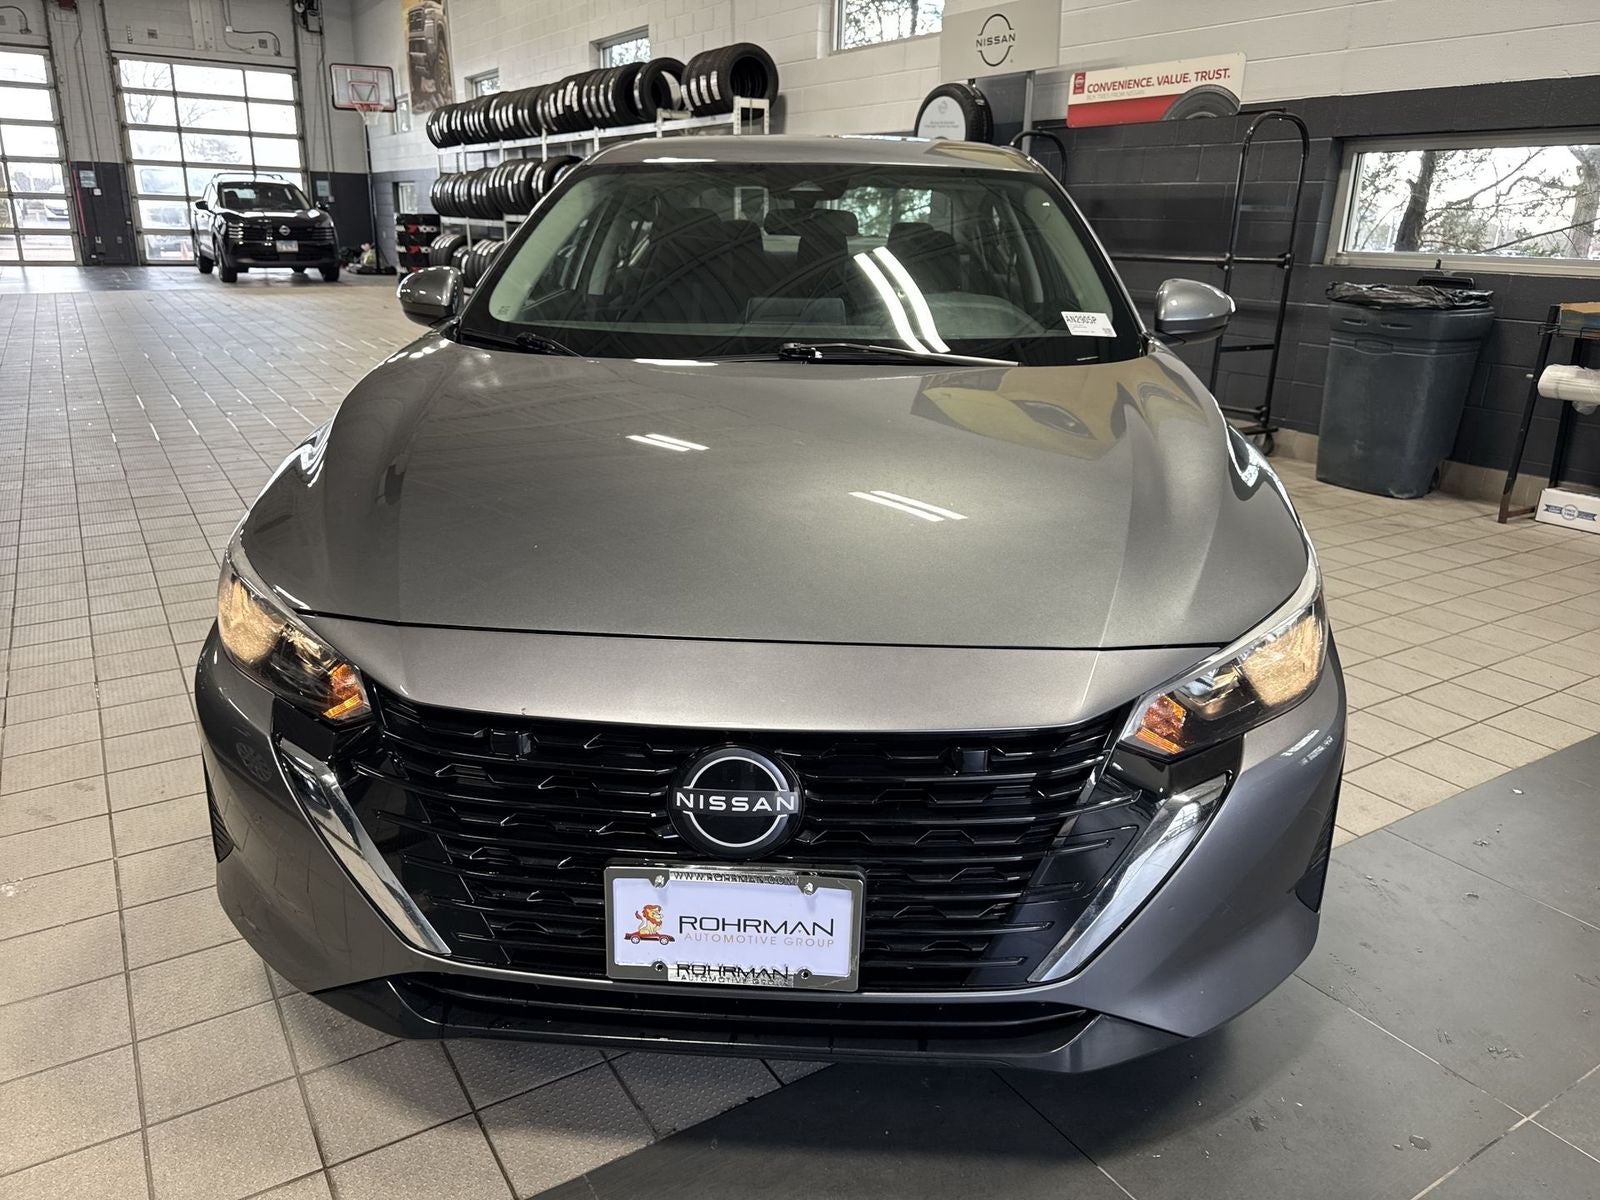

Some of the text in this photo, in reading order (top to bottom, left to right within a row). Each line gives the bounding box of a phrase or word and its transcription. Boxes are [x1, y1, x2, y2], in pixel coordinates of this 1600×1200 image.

[976, 33, 1016, 47] NISSAN
[1087, 68, 1231, 94] CONVENIENCE. VALUE. TRUST.
[676, 791, 795, 812] NISSAN
[673, 871, 798, 886] WWW.ROHRMAN.COM
[679, 916, 834, 937] ROHRMAN
[684, 932, 835, 949] AUTOMOTIVE GROUP
[676, 962, 788, 980] ROHRMAN
